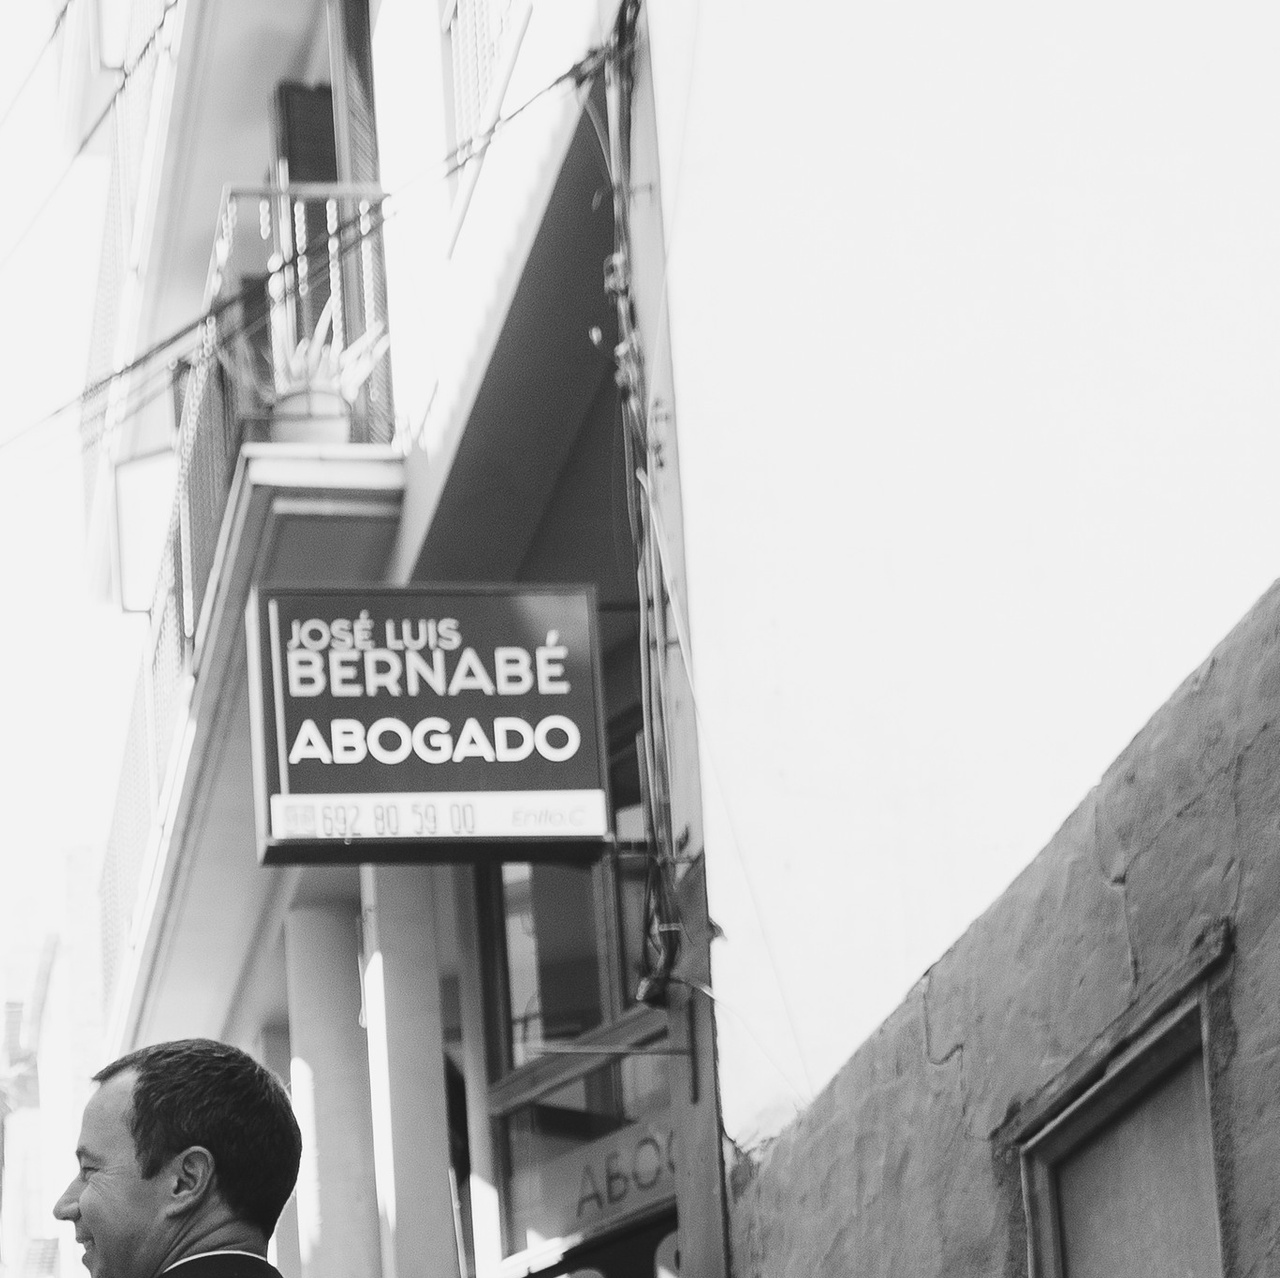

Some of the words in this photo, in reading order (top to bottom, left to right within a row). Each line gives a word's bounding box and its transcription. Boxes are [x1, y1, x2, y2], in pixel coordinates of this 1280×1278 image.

[287, 610, 374, 650] JOSÉ
[386, 618, 462, 650] LUIS
[287, 630, 571, 697] BERNABÉ
[288, 715, 581, 765] ABOGADO
